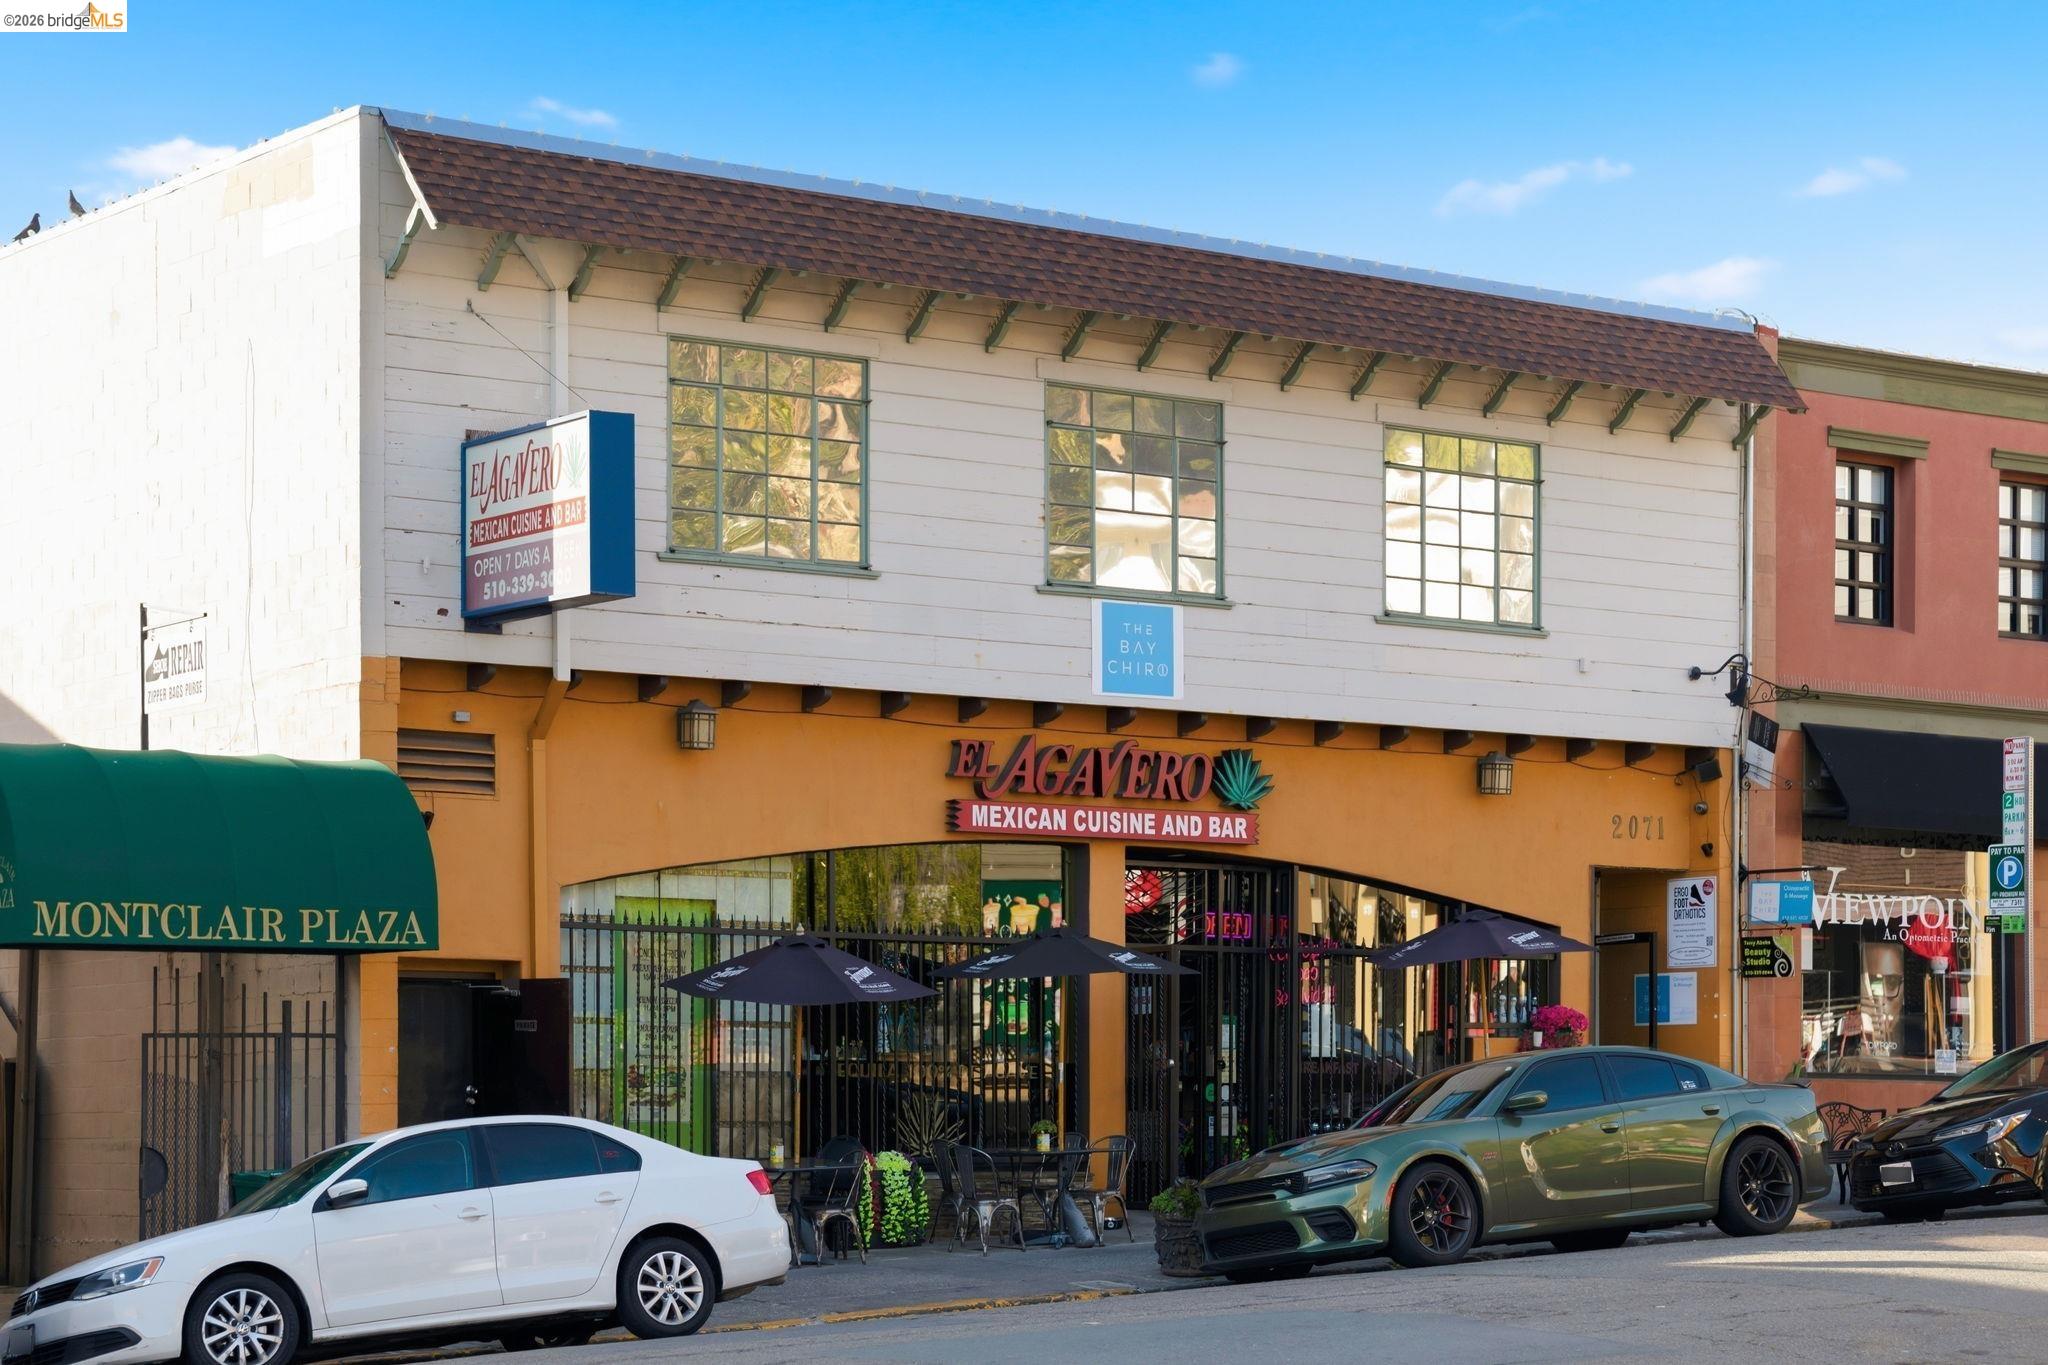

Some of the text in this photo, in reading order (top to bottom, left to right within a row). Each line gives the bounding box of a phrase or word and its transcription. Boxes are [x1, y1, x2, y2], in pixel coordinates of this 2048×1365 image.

[470, 439, 562, 514] EL AGAVERO
[473, 501, 582, 544] MEXICAN CUISINE AND BAR
[474, 559, 502, 578] OPEN
[505, 557, 511, 573] 7
[515, 550, 540, 569] DAYS
[542, 548, 551, 565] A
[1123, 622, 1153, 636] THE
[1119, 639, 1157, 656] BAY
[170, 640, 205, 677] REPAIR
[1107, 659, 1170, 678] CHIRO
[147, 681, 203, 704] ZIPPER BAGS PURSE
[946, 733, 1214, 801] EL AGAVERO
[2005, 796, 2025, 807] 2 HOU
[971, 804, 1248, 840] MEXICAN CUISINE AND BAR
[2005, 812, 2025, 823] PARKIN
[1611, 814, 1666, 841] 2071
[1990, 846, 2025, 856] PAY TO PAR
[1673, 886, 1689, 898] ERGO
[1801, 867, 1985, 931] VIEWPOIN
[1673, 898, 1689, 909] FOOT
[1673, 908, 1706, 920] ORTHOTICS
[32, 901, 427, 945] MONTCLAIR PLAZA
[1883, 928, 1982, 945] An Optometric Pract
[1744, 948, 1771, 958] Beauty
[1746, 957, 1771, 966] Studio
[1301, 1061, 1359, 1074] REAKFAST
